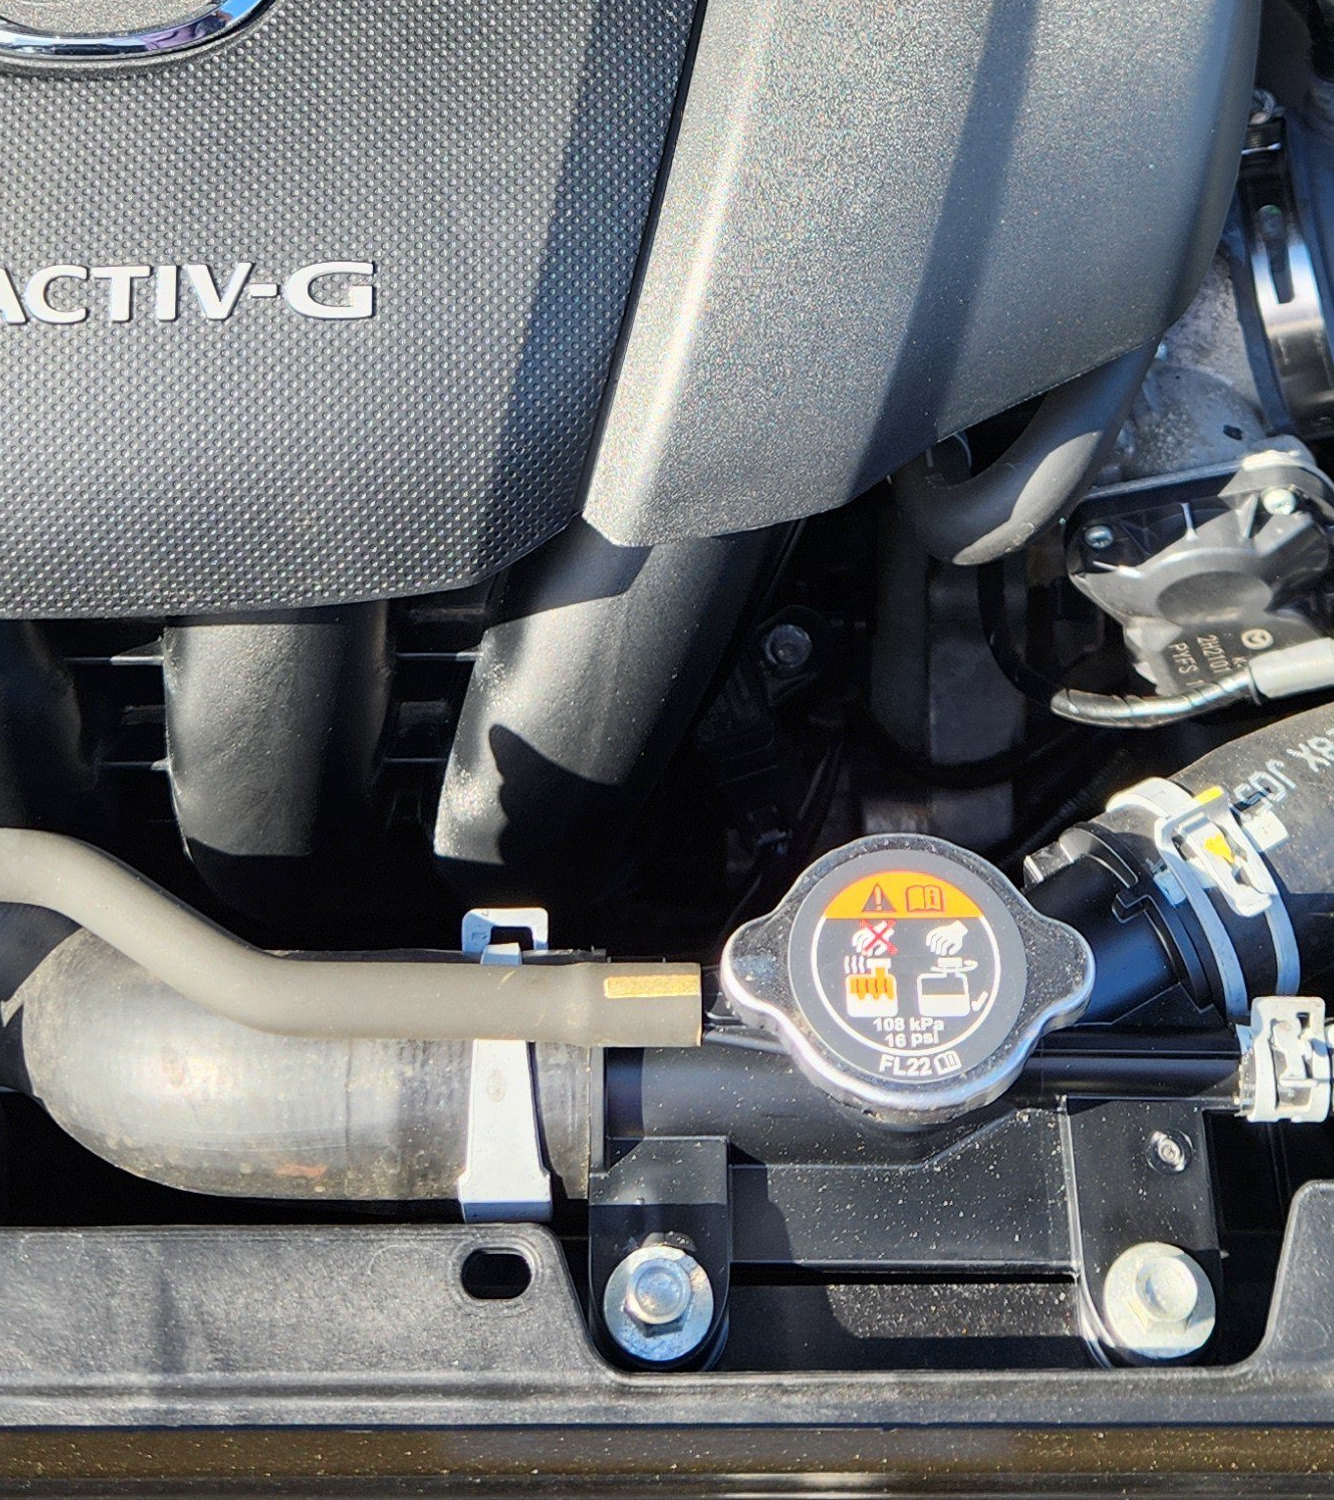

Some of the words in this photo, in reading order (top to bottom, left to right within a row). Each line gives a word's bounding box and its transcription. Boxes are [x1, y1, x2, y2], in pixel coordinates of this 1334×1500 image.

[872, 1016, 906, 1032] 108
[909, 1016, 945, 1031] kPa
[884, 1032, 907, 1048] 16
[910, 1028, 939, 1049] psi
[879, 1053, 933, 1077] FL22
